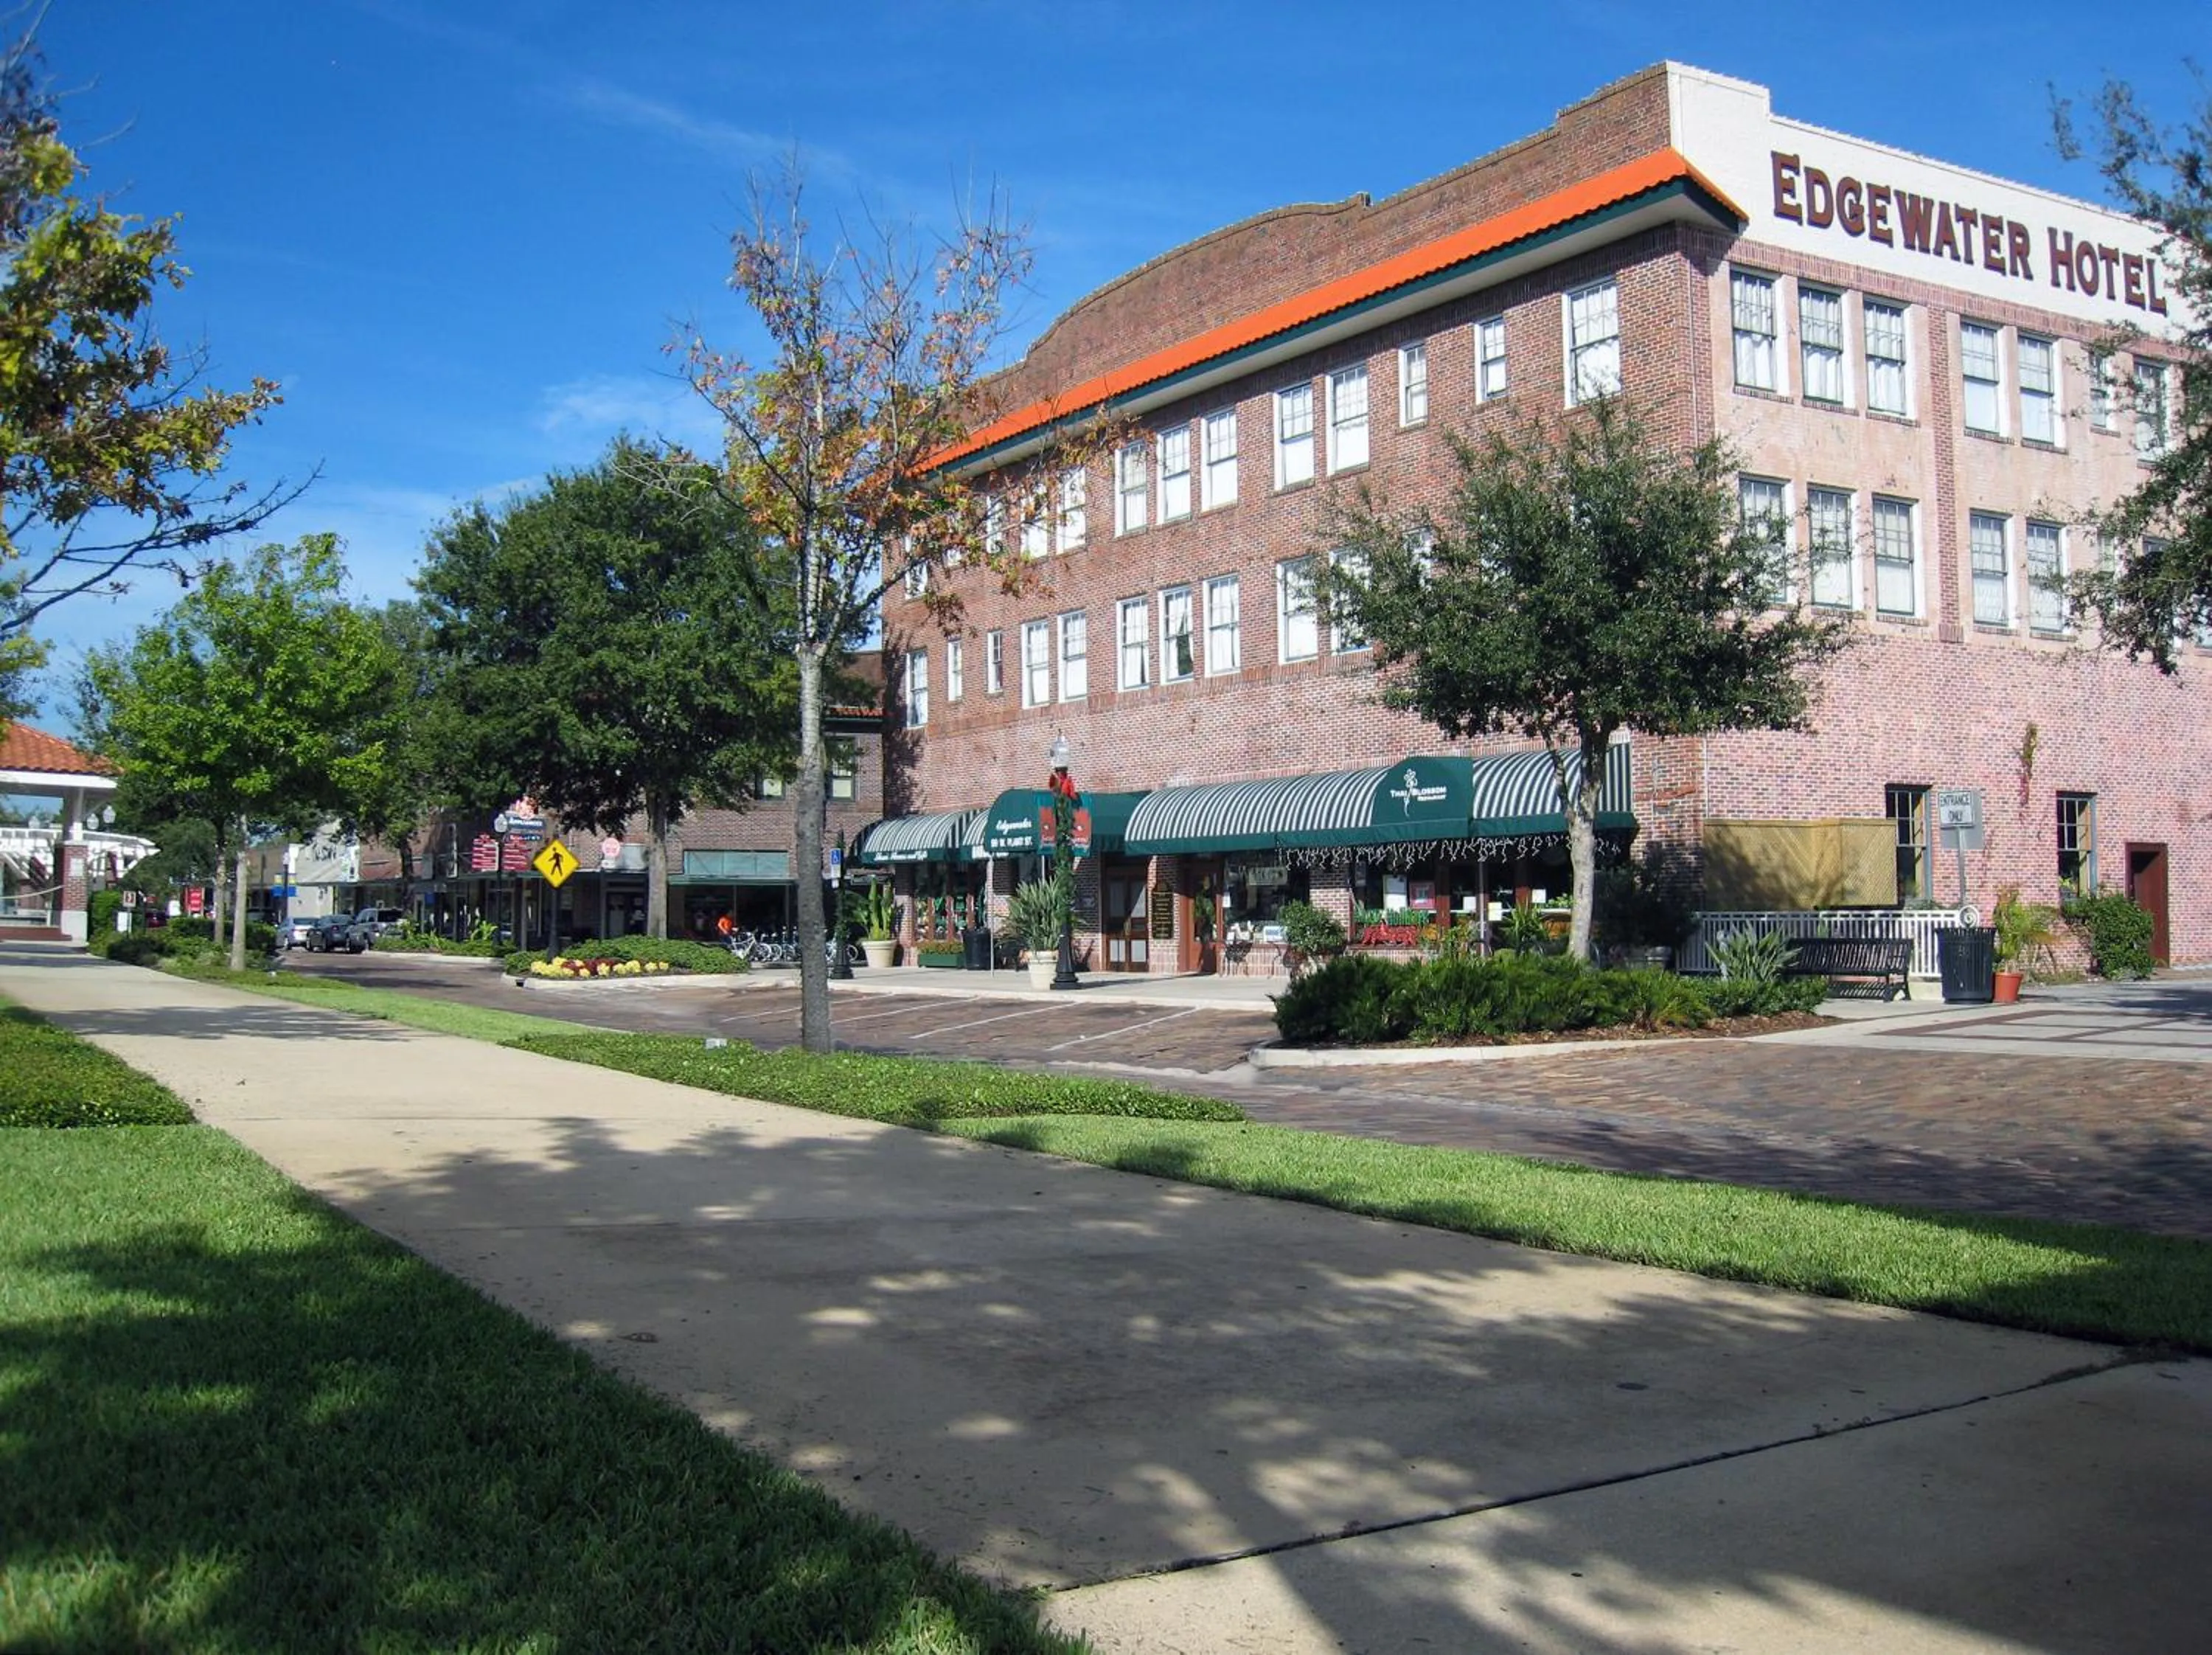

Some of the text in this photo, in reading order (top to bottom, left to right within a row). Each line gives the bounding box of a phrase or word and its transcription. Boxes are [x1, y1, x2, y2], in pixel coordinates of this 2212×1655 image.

[1771, 150, 2167, 317] EDGEWATER HOTEL
[1411, 786, 1447, 797] BLOSSOM
[1940, 794, 1969, 807] ENTRANCE
[1948, 811, 1963, 822] ONLY
